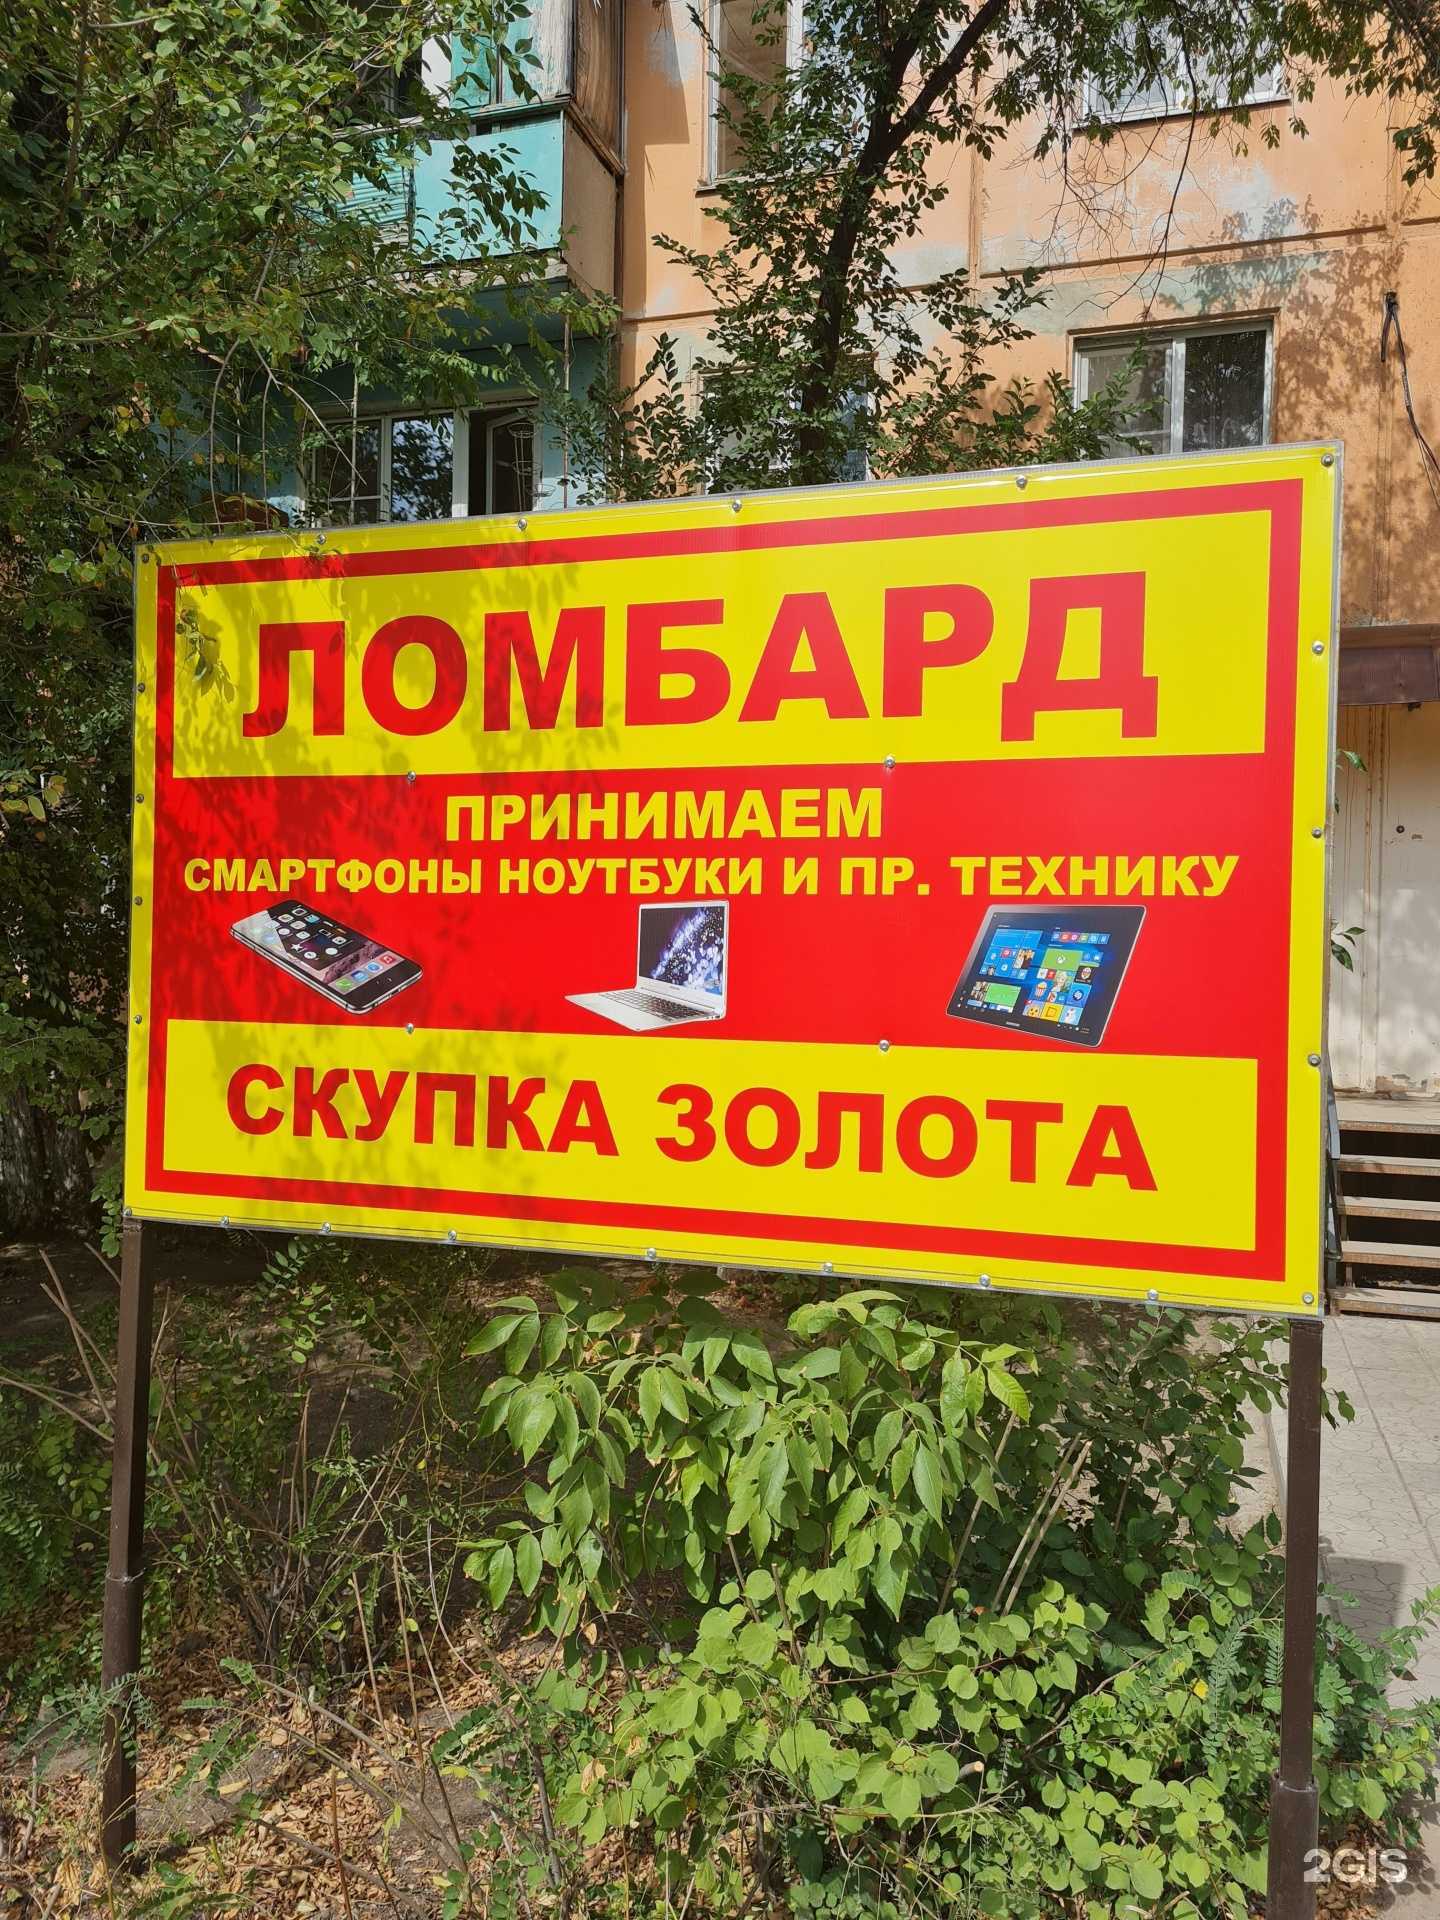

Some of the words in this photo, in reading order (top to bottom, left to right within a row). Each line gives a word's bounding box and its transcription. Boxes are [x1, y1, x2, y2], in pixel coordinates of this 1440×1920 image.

[242, 571, 1159, 742] ЛОМБАРД
[446, 787, 882, 842] ПРИНИМАЕМ
[184, 857, 482, 894] СМАРТФОНЫ
[498, 857, 763, 896] НОУТБУКИ
[783, 857, 819, 895] И
[840, 857, 930, 896] ПР.
[950, 855, 1239, 897] ТЕХНИКУ
[227, 1063, 619, 1157] СКУПКА
[655, 1083, 1157, 1191] ЗОЛОТА
